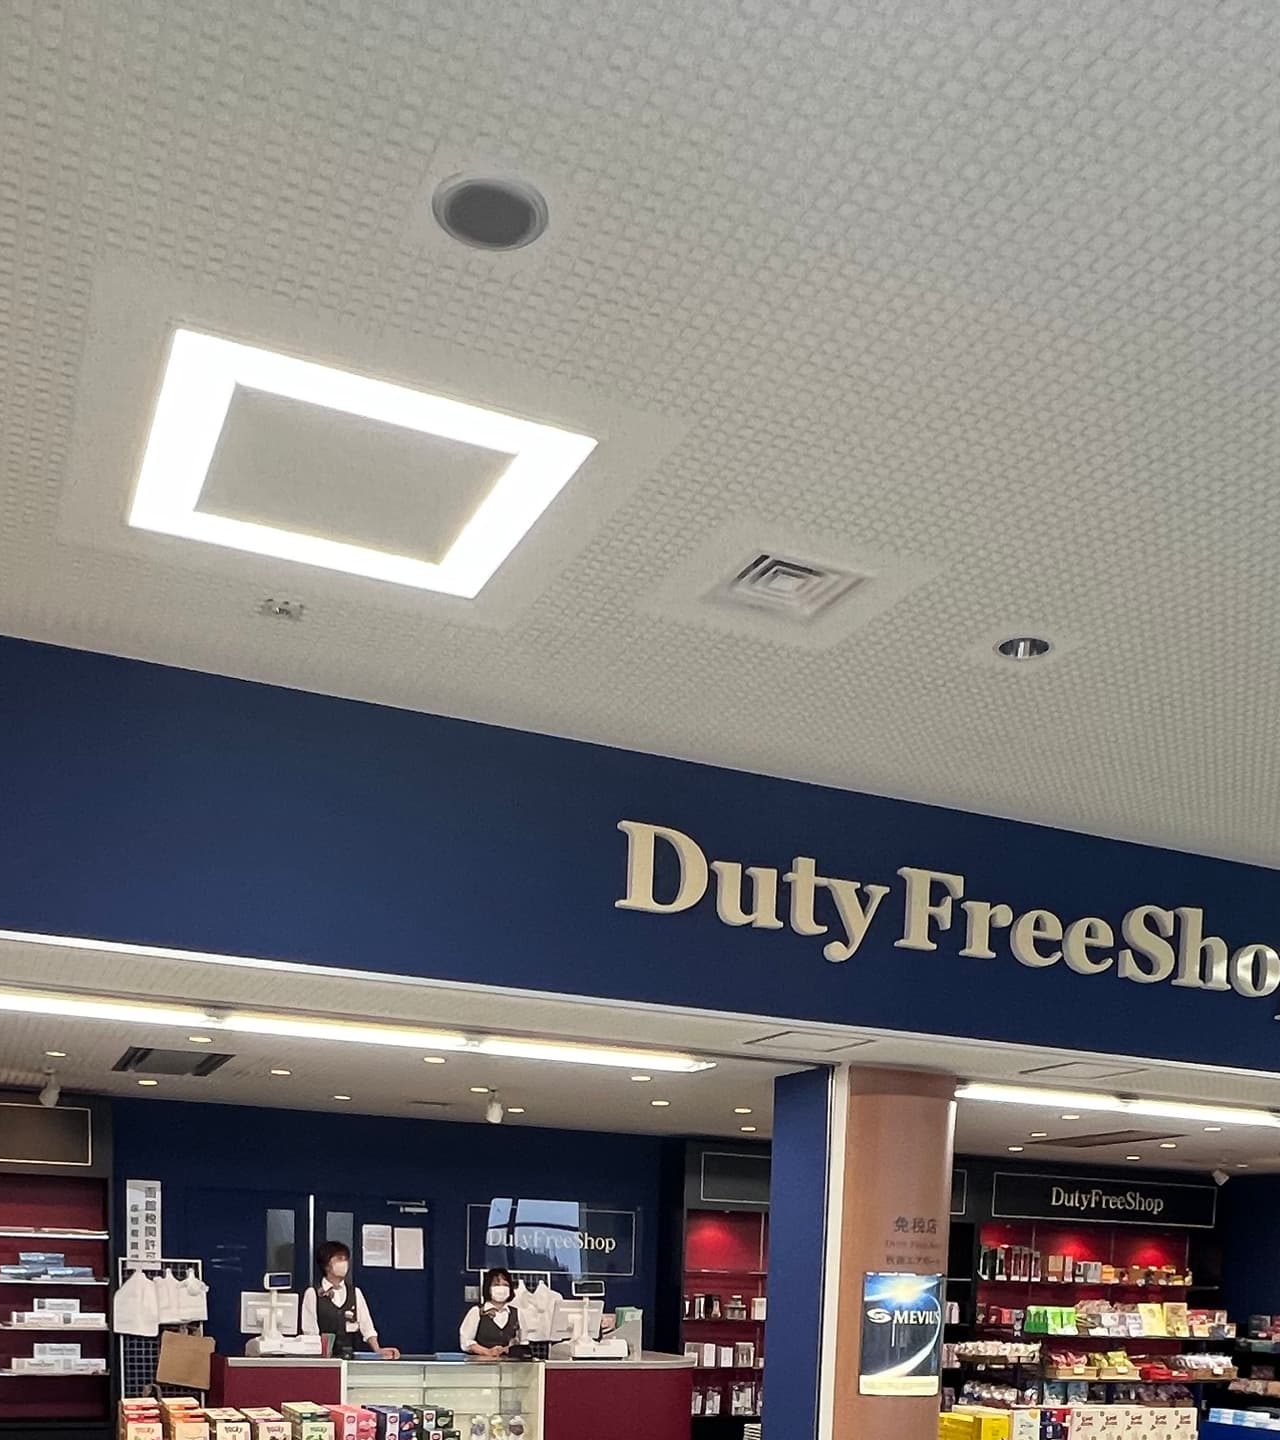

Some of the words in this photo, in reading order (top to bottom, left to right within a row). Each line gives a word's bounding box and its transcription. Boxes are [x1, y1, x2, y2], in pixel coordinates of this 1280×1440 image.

[1051, 1186, 1164, 1215] DutyFreeShop
[894, 1215, 937, 1234] 免税店
